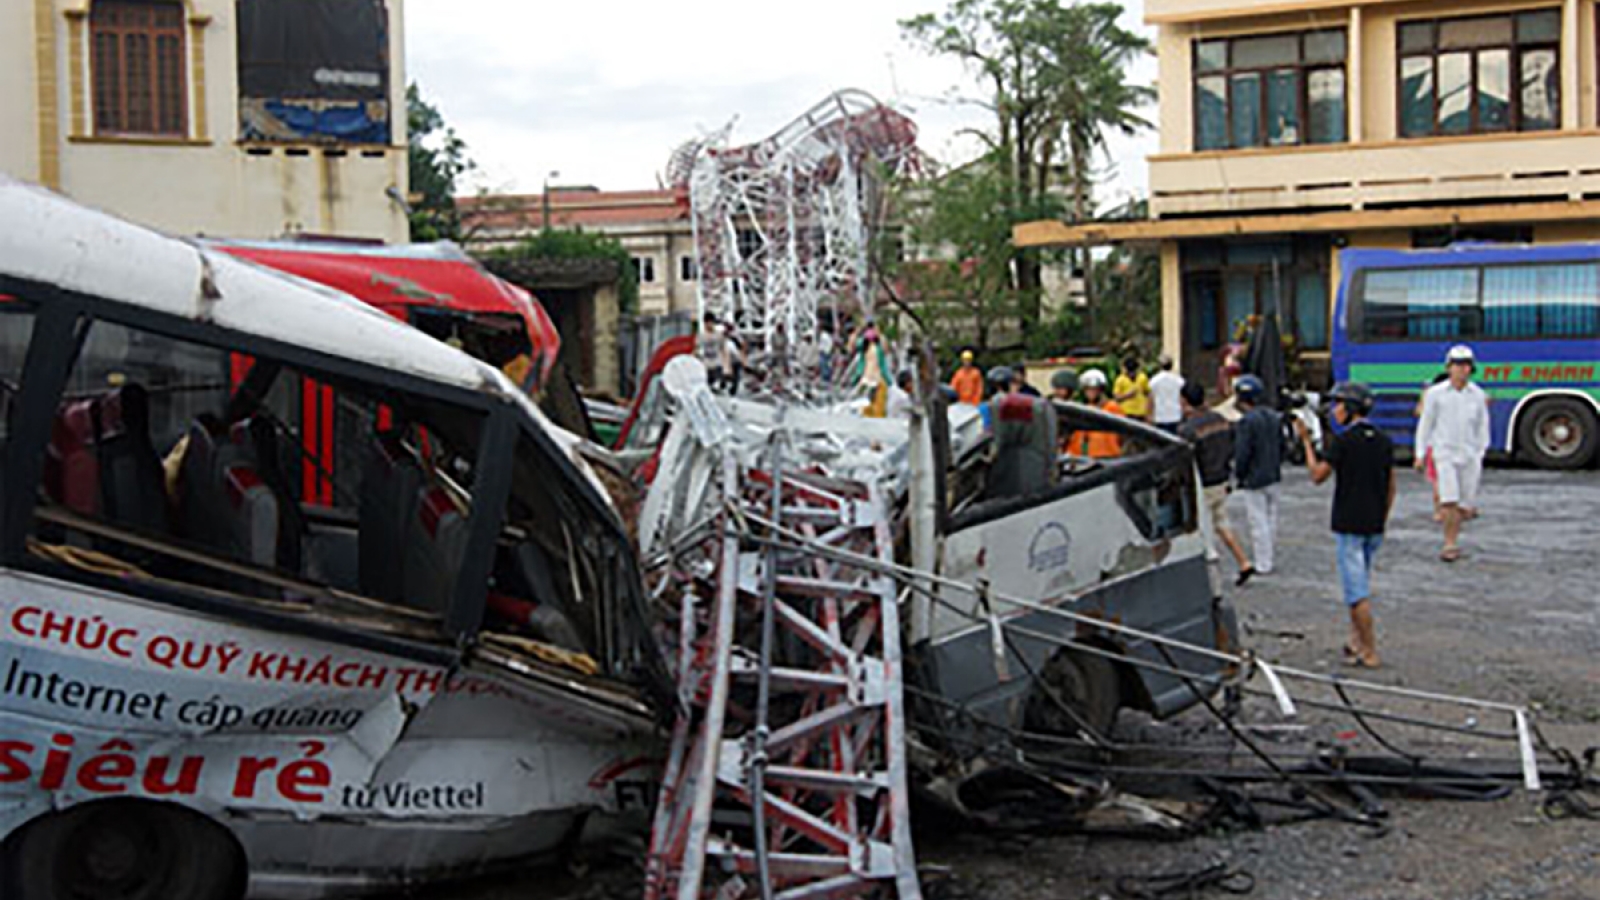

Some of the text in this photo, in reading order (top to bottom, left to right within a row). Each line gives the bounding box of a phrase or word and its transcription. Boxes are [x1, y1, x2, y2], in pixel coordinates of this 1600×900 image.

[11, 605, 138, 658] CHÚC
[248, 651, 388, 690] KHÁCH
[4, 658, 169, 720] Internet
[178, 694, 243, 731] cáp
[0, 733, 332, 803] siêu rẻ
[383, 781, 484, 809] Viettel
